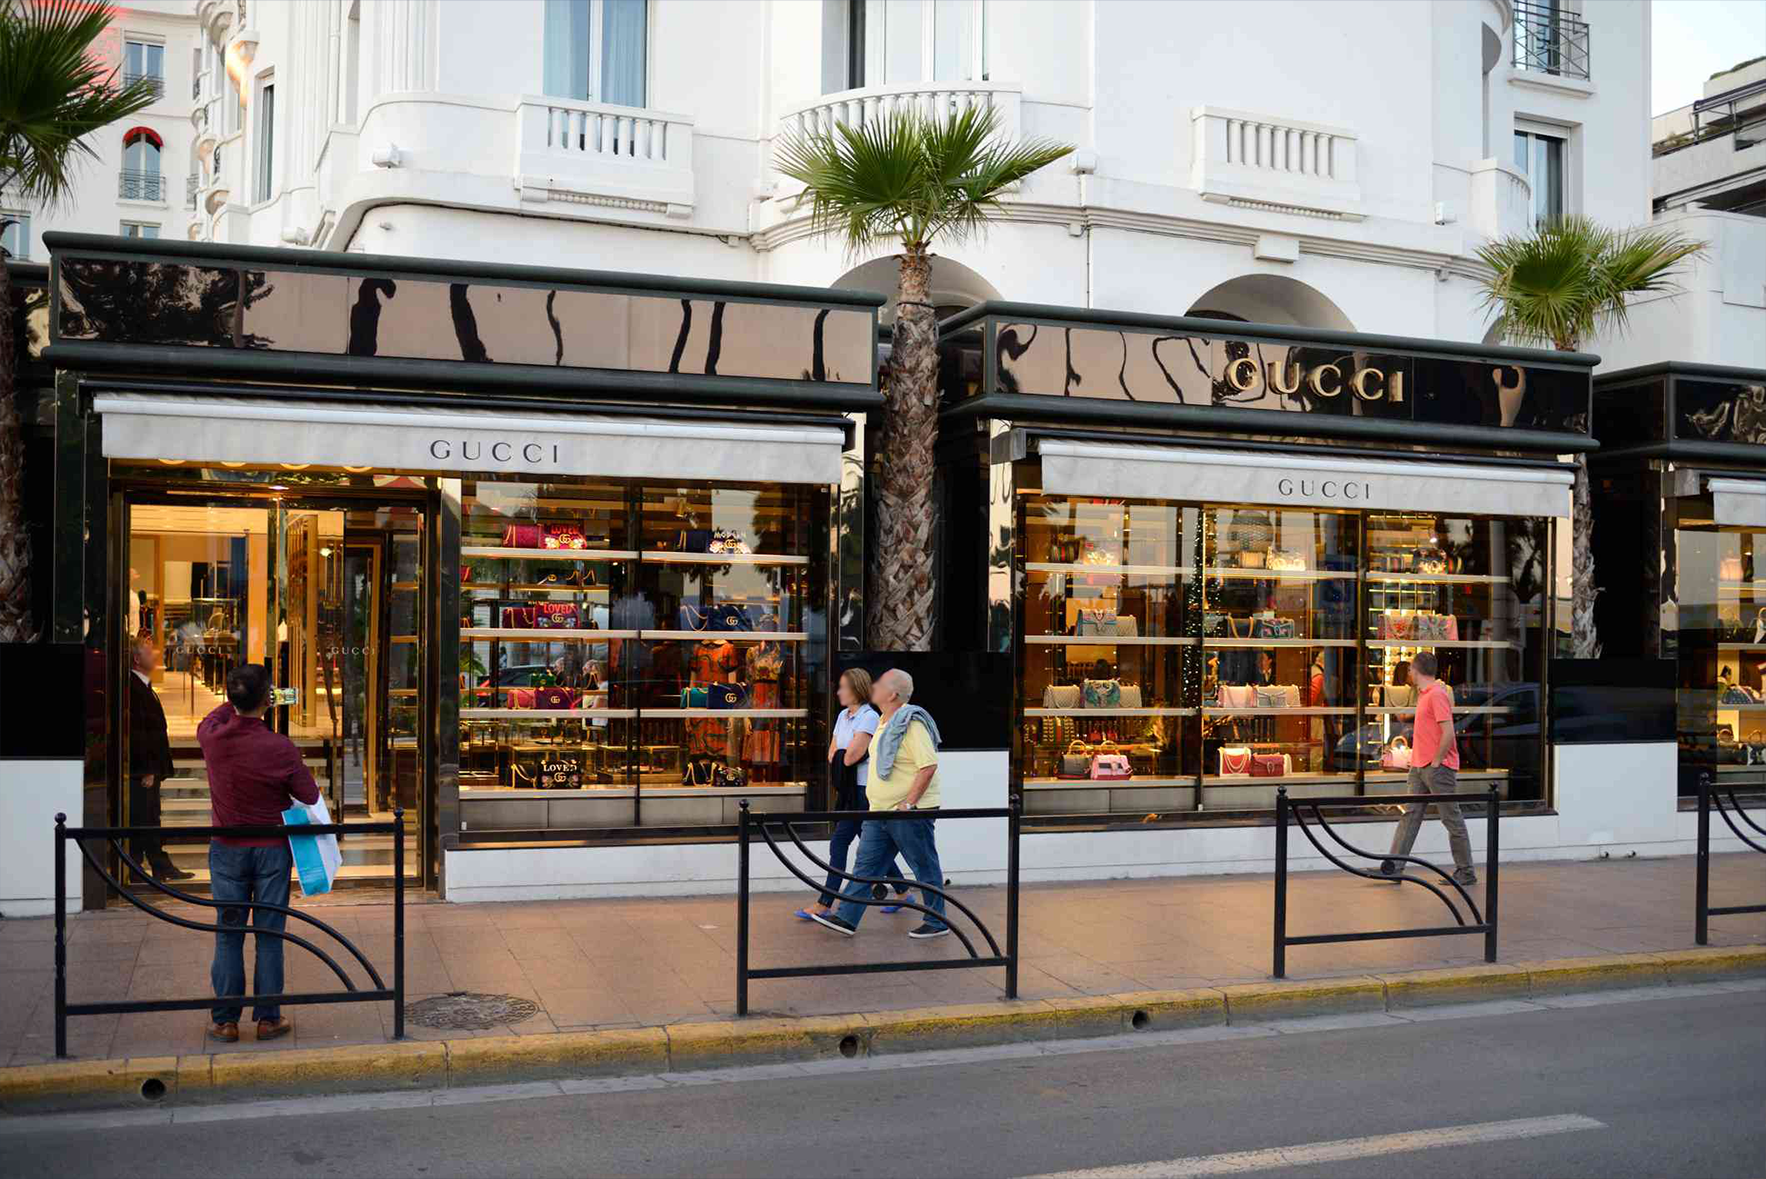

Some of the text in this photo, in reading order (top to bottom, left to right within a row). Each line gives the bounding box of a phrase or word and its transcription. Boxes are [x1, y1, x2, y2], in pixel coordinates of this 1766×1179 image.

[1224, 358, 1404, 402] GUCCI
[430, 440, 557, 463] GUCCI
[1278, 479, 1370, 499] GUCCI
[544, 603, 572, 614] LOVED
[175, 646, 221, 654] GUCCI
[331, 646, 375, 655] GUCCI
[543, 763, 577, 772] LOVED
